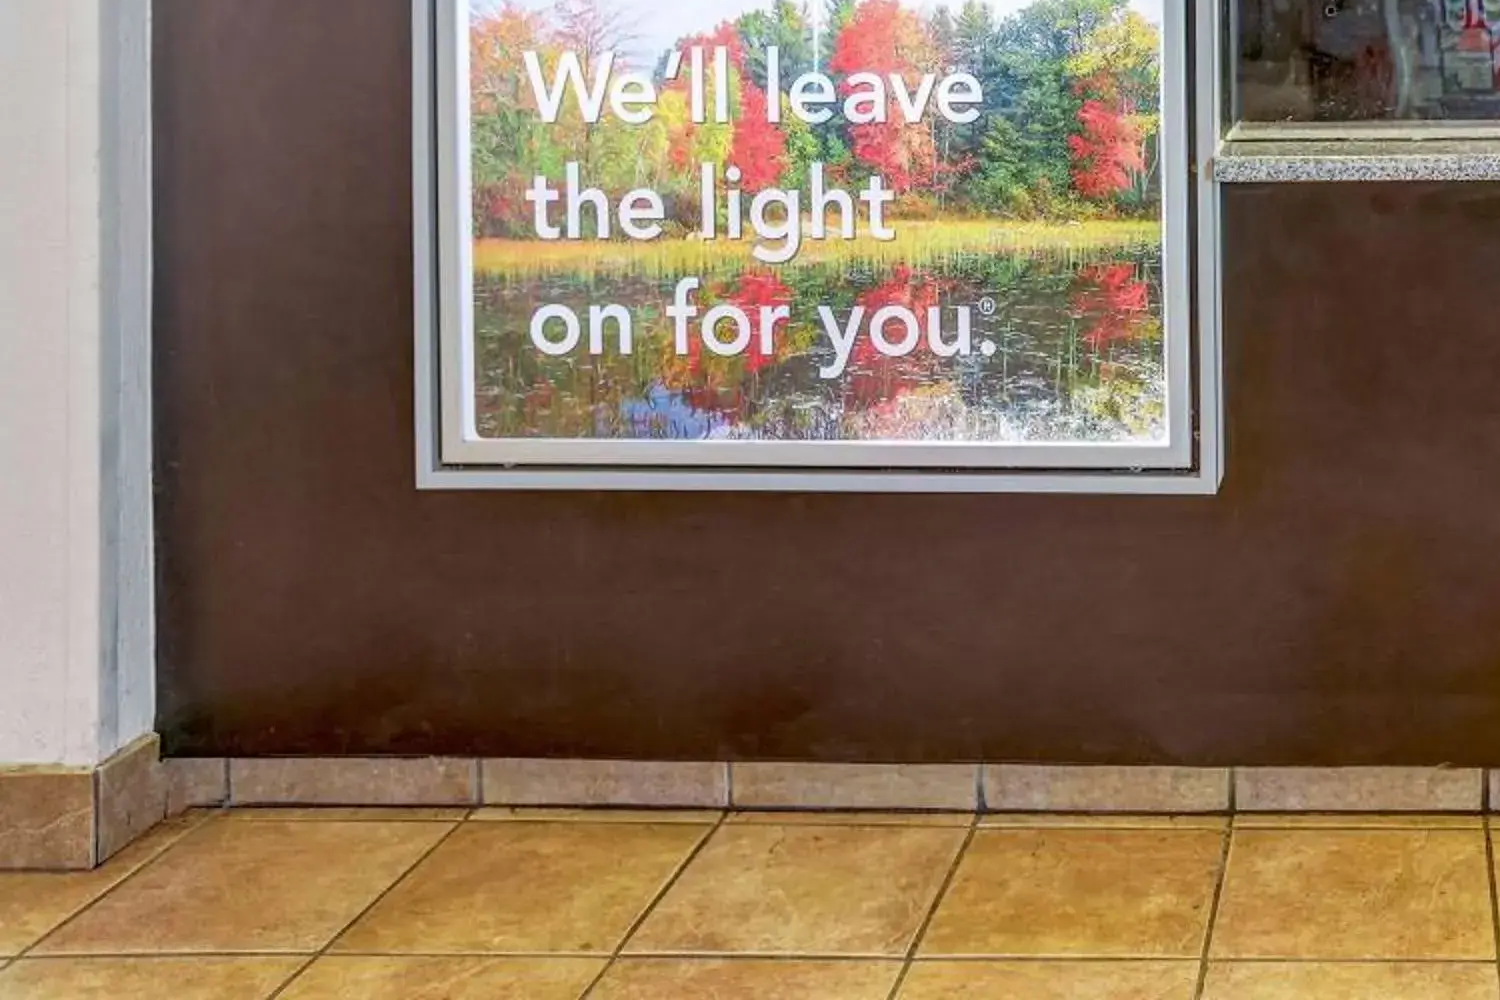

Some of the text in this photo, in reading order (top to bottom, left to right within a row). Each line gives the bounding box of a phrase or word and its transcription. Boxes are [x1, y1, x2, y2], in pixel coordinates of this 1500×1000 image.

[522, 45, 984, 124] We'll leave
[525, 160, 896, 263] the light
[530, 303, 633, 356] on
[665, 276, 791, 356] for
